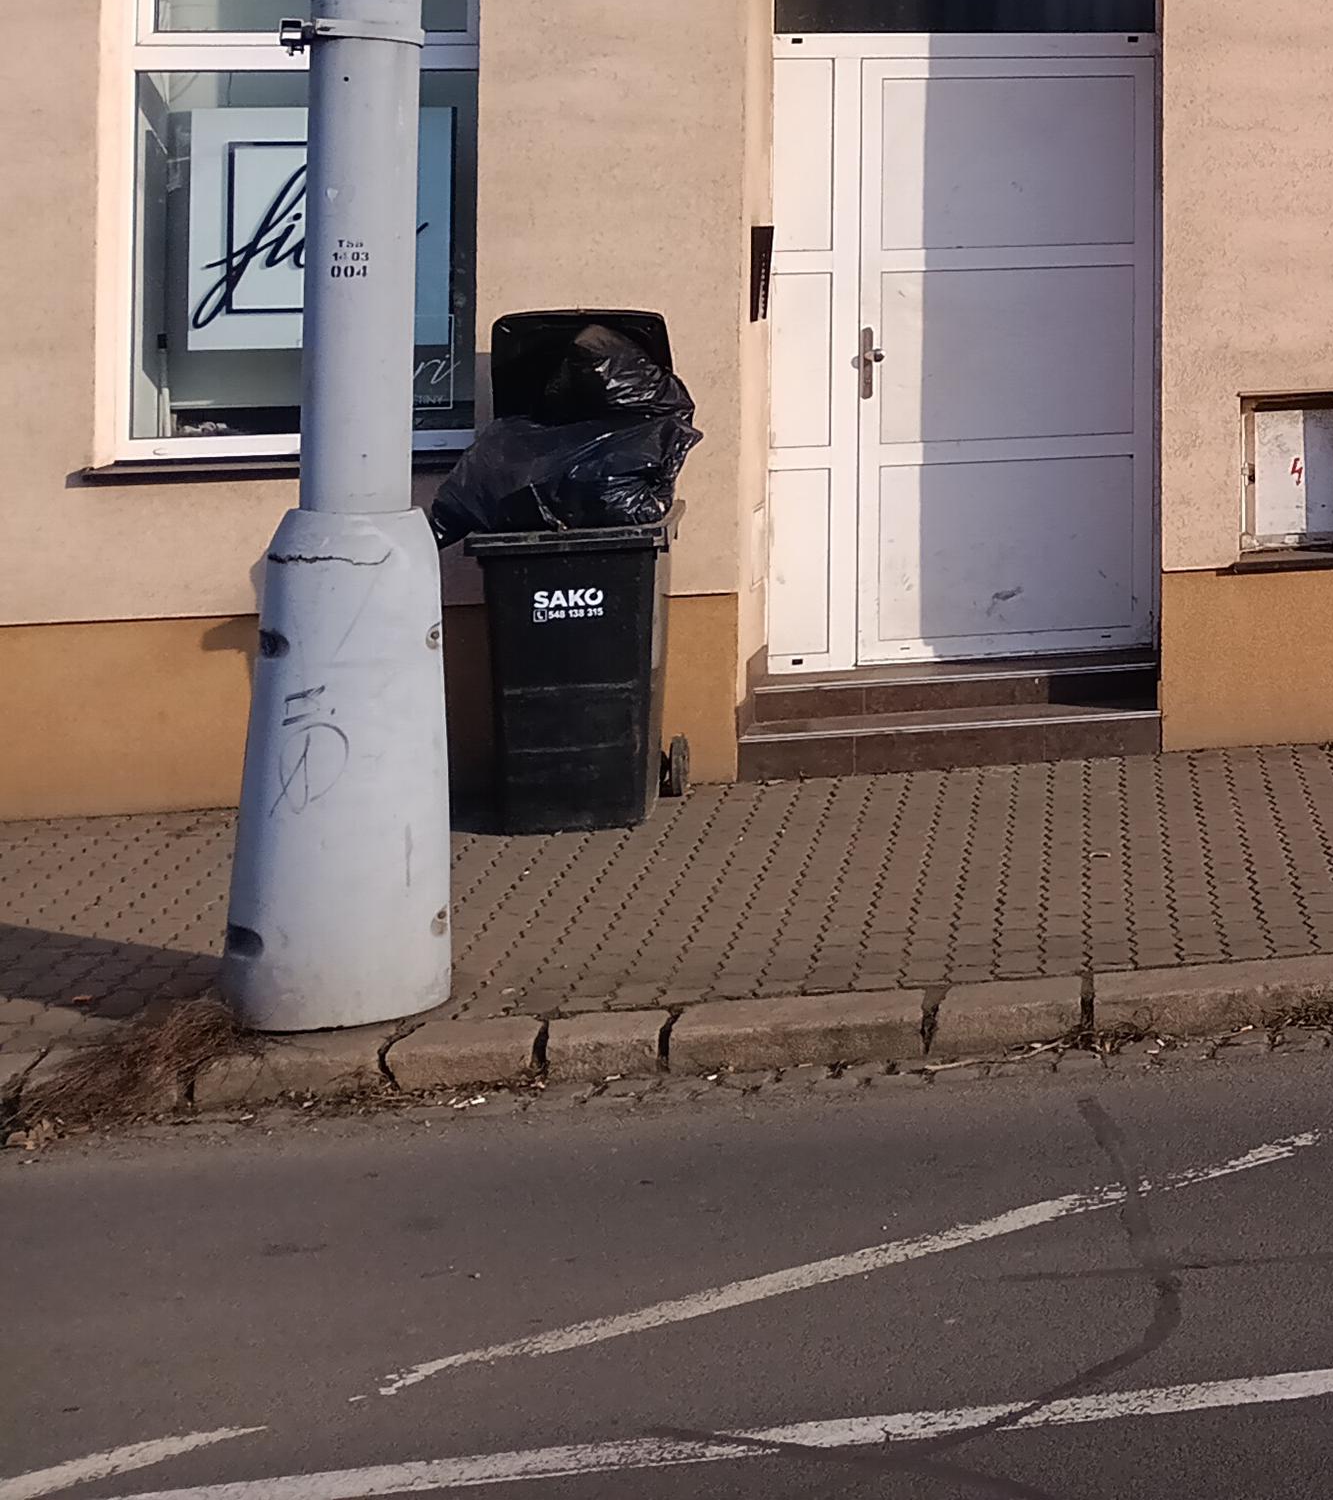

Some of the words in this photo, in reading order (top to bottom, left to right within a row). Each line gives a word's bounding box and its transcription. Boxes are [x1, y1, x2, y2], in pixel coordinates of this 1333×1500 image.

[330, 265, 368, 278] 004
[533, 587, 604, 609] SAKO
[548, 610, 566, 620] 548
[568, 608, 585, 619] 138
[587, 606, 604, 617] 315
